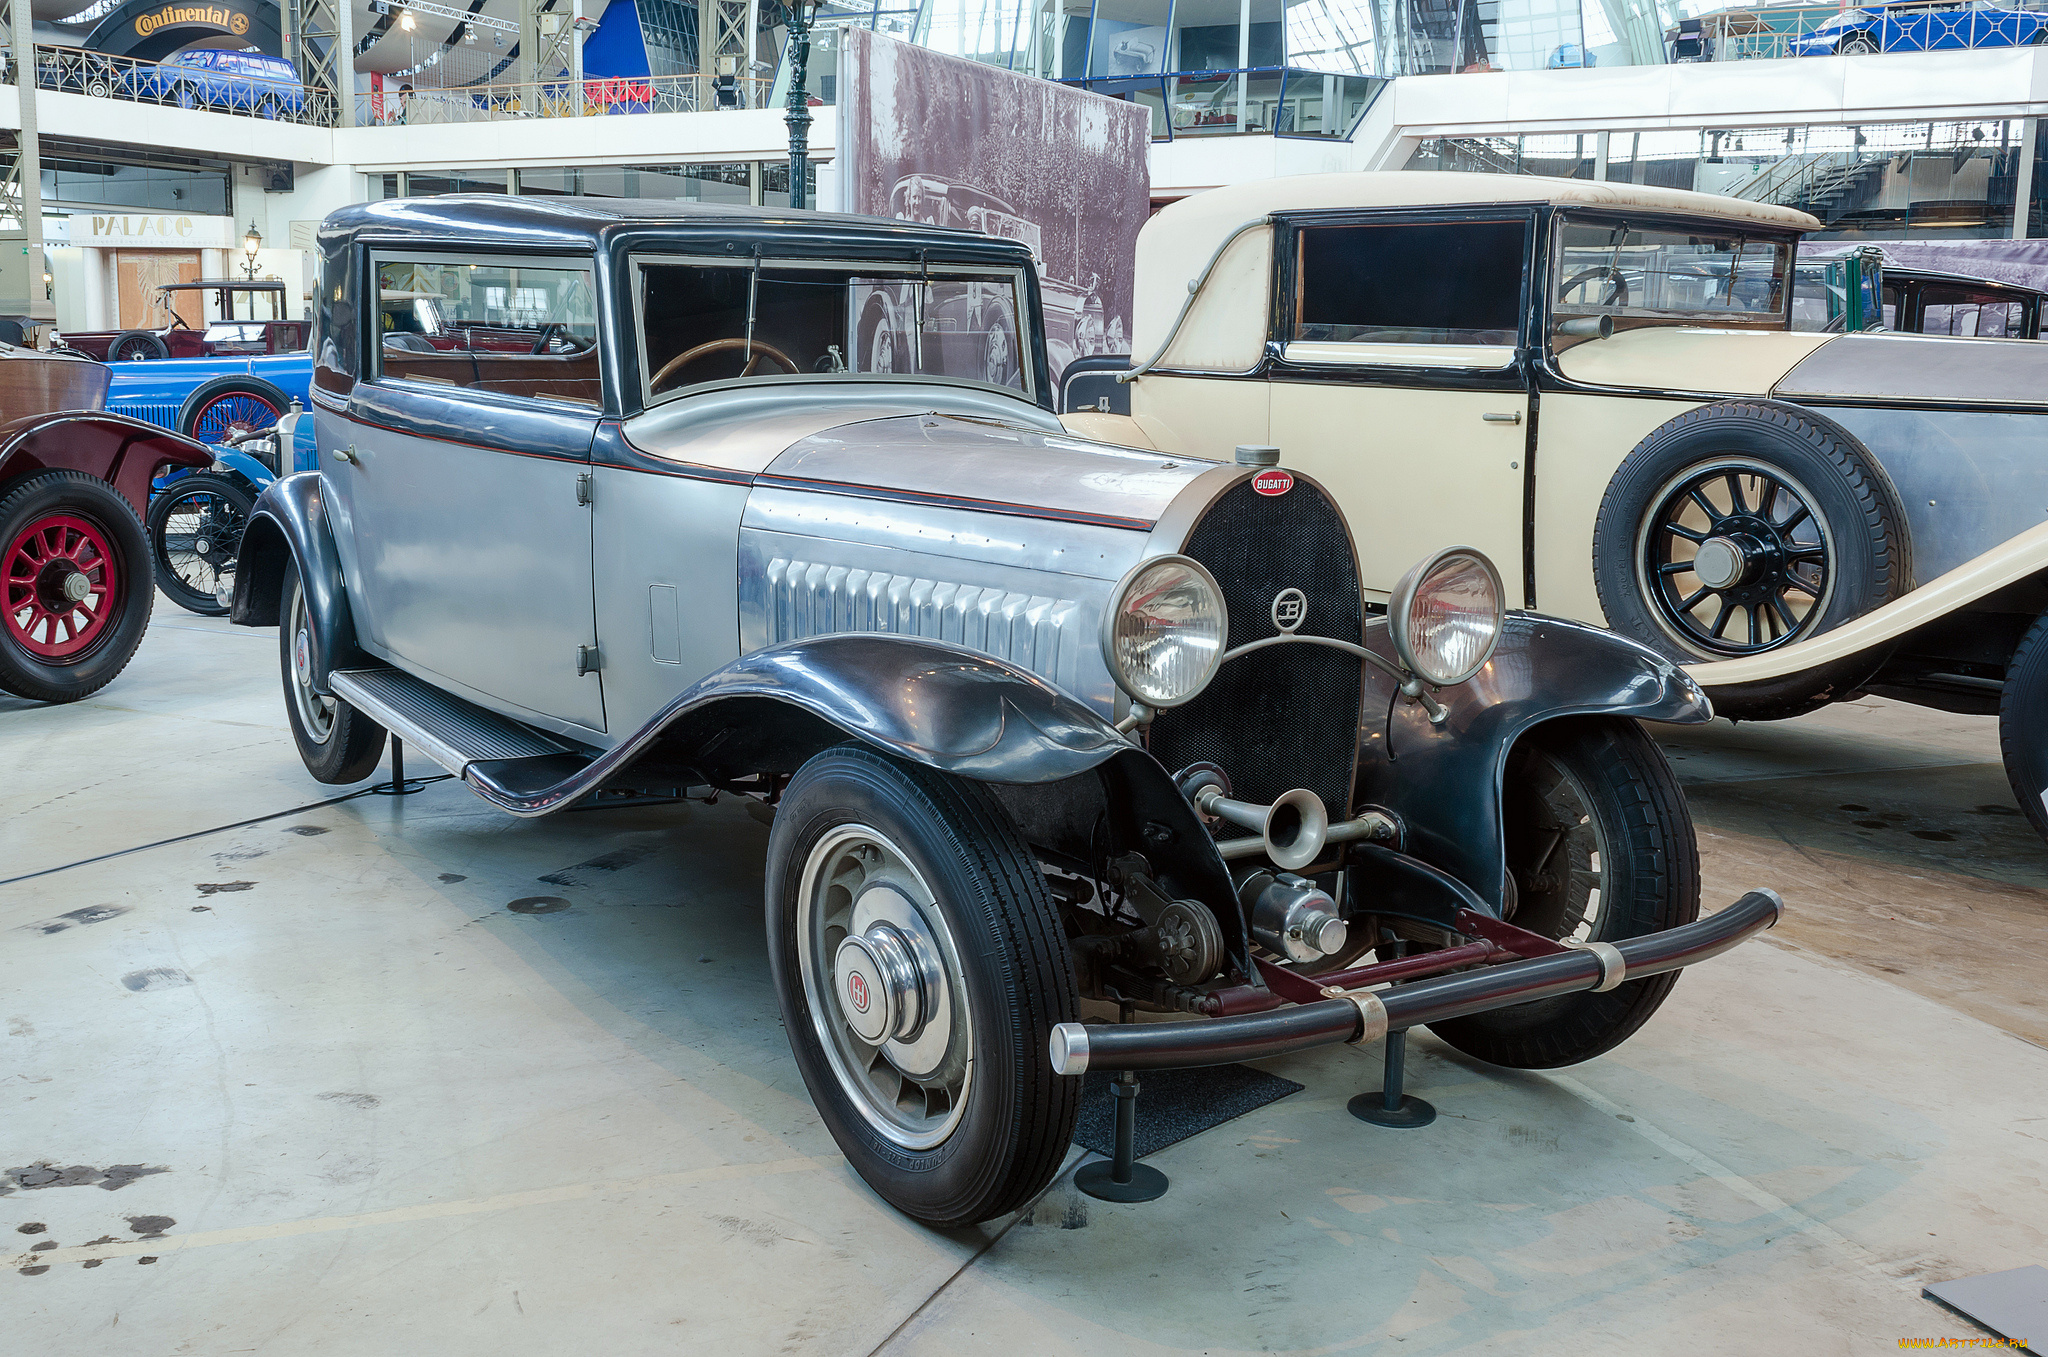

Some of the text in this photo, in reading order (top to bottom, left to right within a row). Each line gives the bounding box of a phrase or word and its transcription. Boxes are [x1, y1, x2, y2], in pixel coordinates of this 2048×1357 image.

[135, 5, 230, 36] Continental
[92, 216, 193, 237] PALACE
[1256, 479, 1290, 490] BUGATTI
